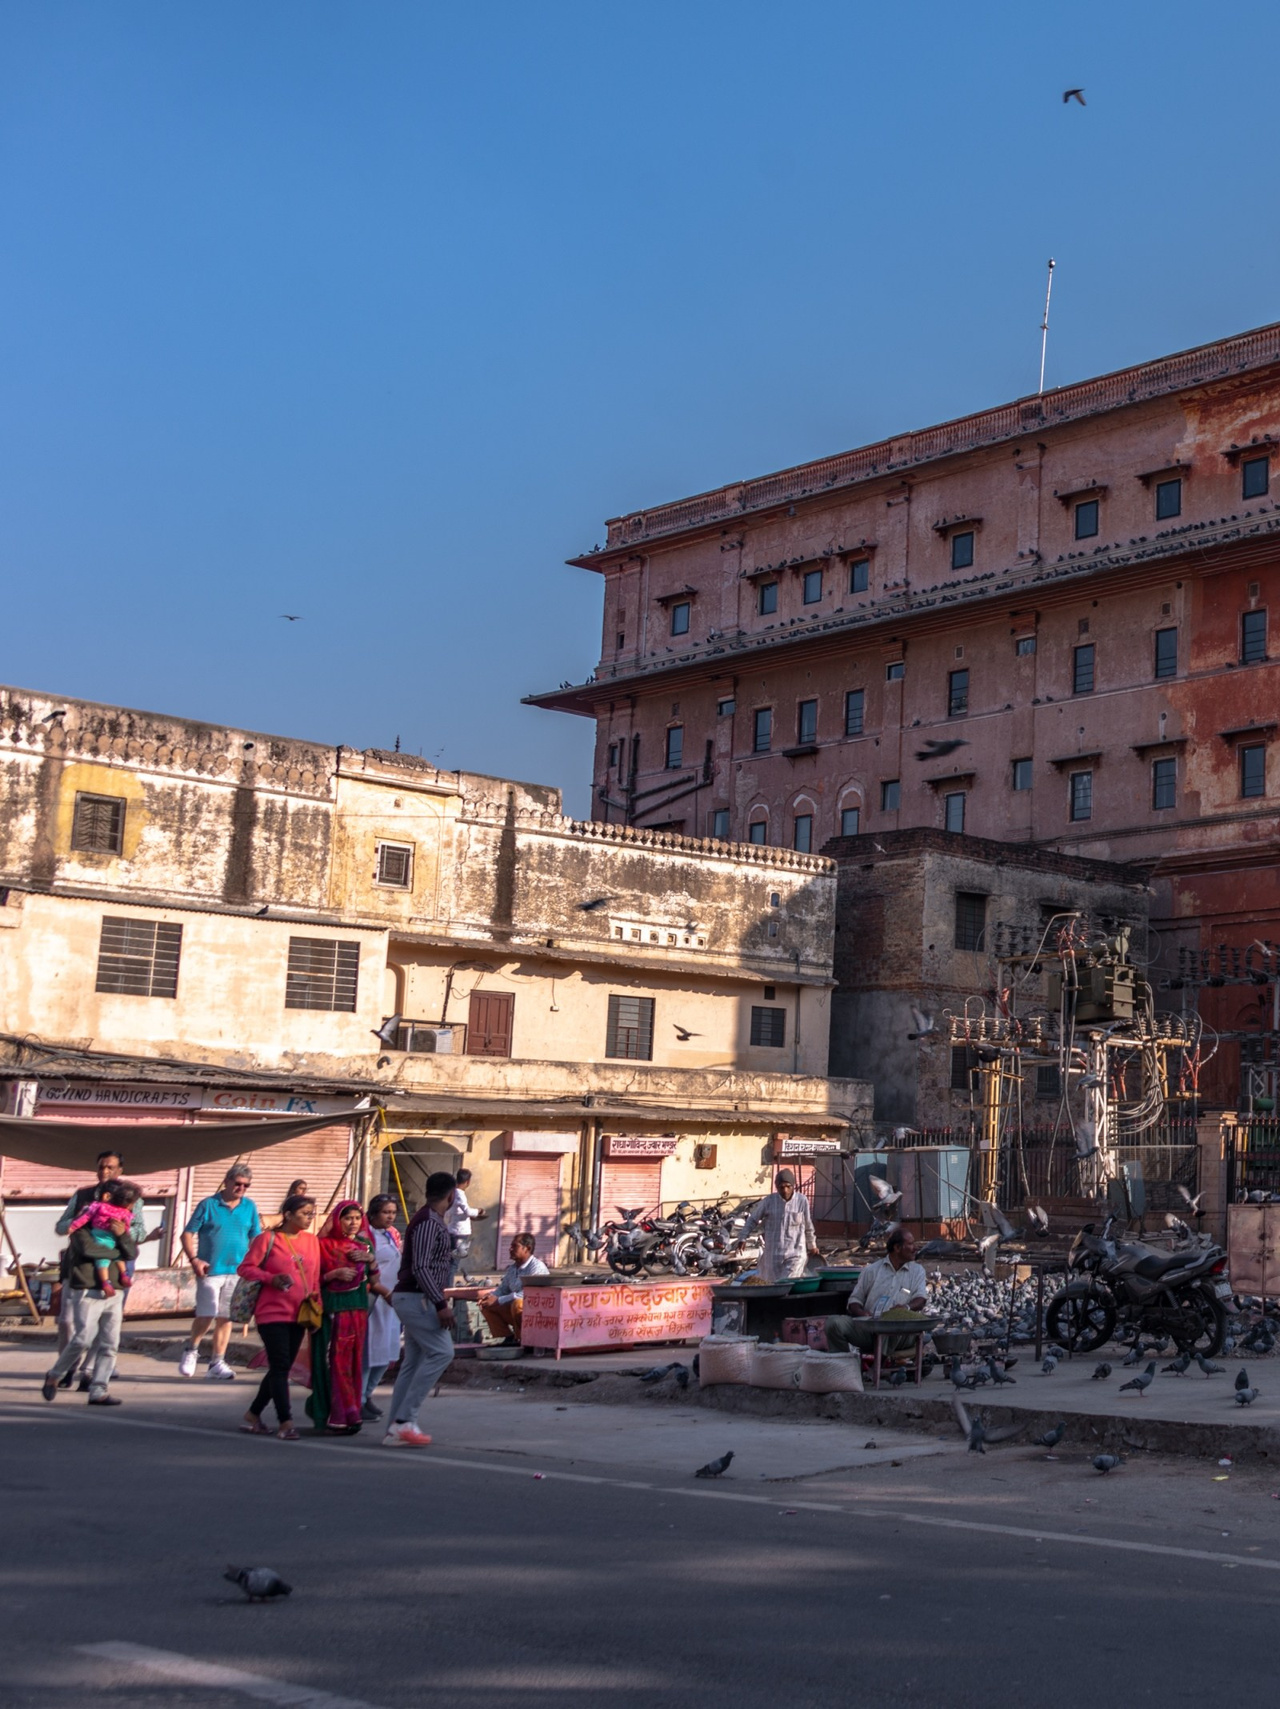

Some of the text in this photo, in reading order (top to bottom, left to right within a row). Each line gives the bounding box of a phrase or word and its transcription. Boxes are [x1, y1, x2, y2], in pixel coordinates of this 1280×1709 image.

[46, 1087, 92, 1100] GOVIND
[95, 1089, 191, 1105] HANDICRAFTS
[213, 1093, 317, 1113] Coin Fx
